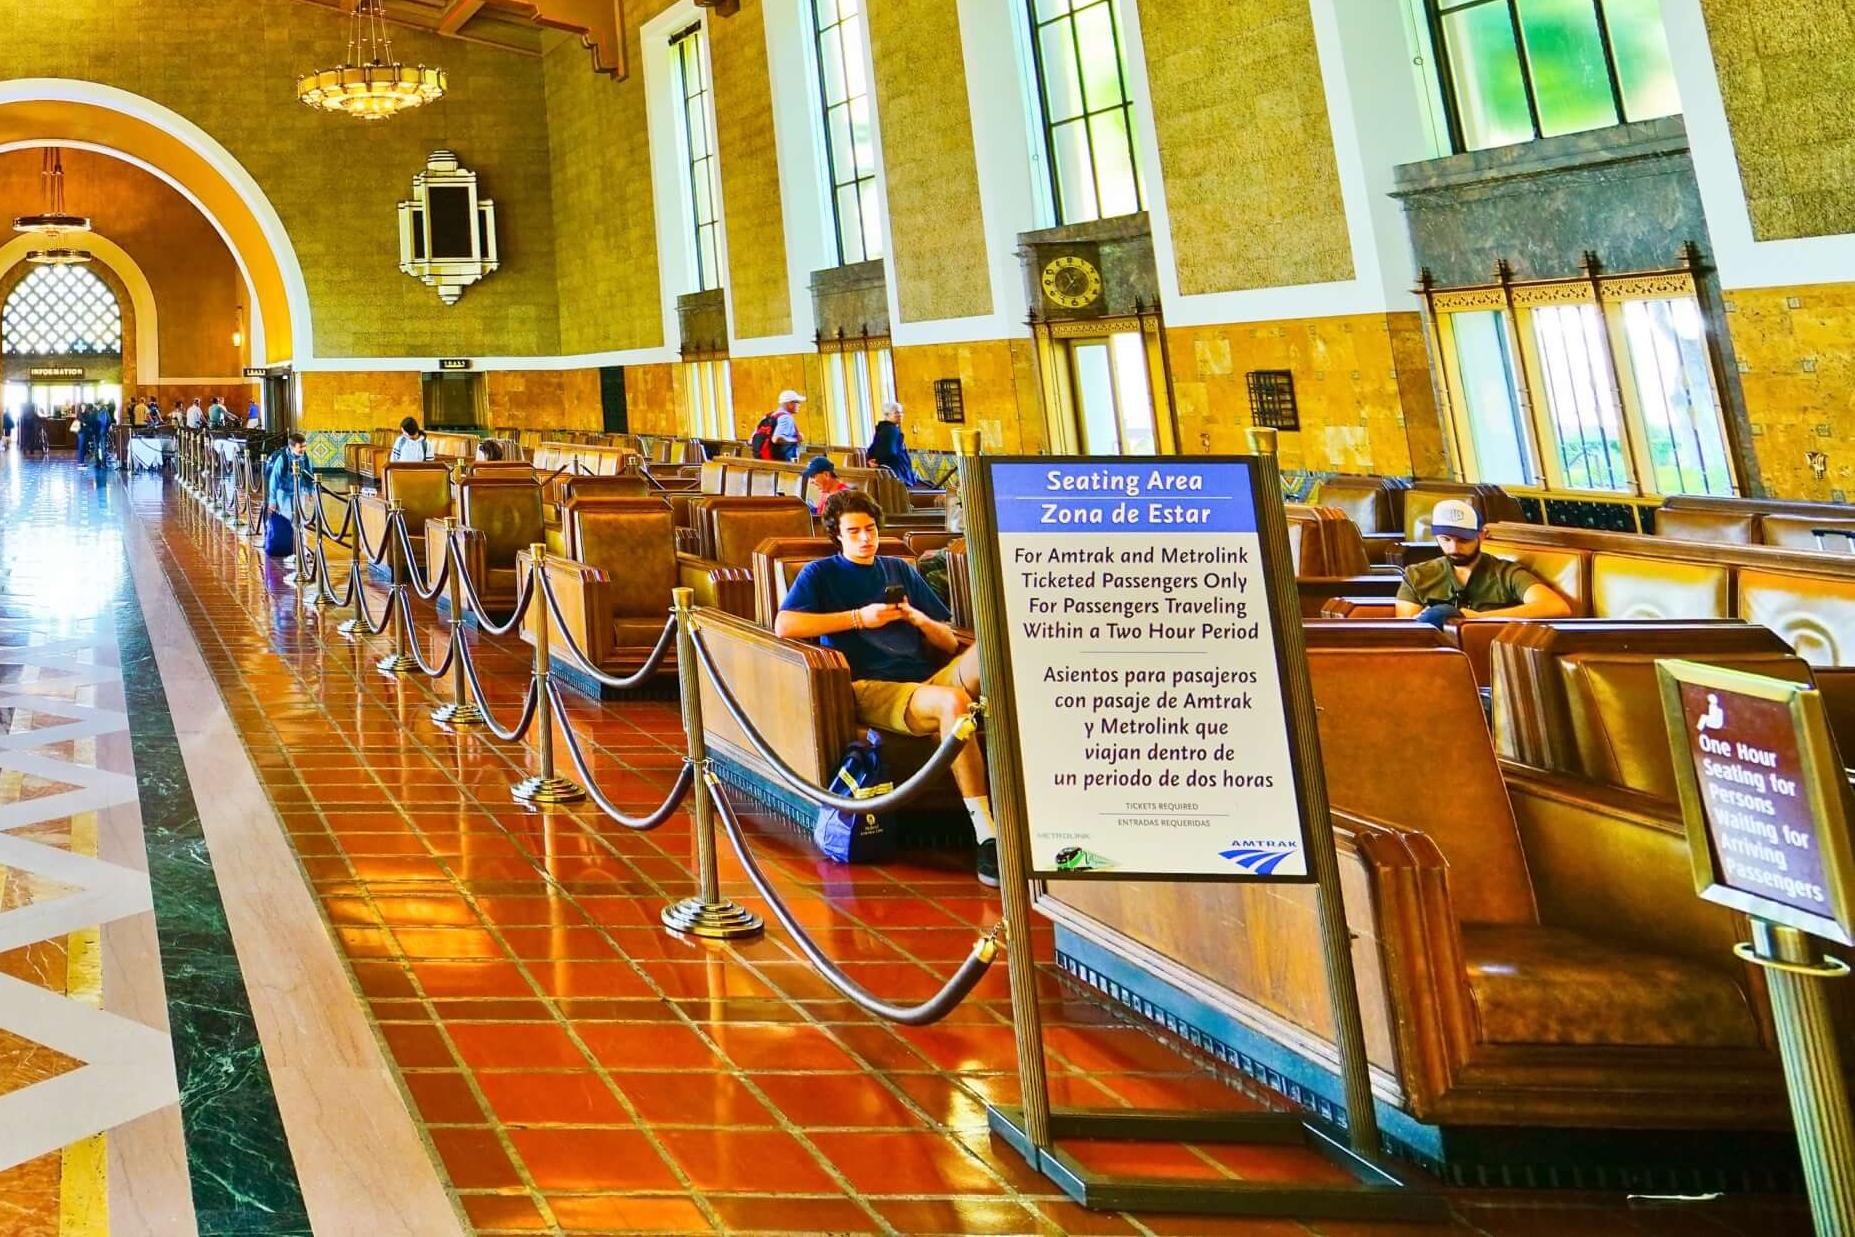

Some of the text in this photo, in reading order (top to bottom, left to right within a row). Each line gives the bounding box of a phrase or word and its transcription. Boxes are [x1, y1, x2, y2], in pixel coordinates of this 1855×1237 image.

[1047, 470, 1203, 496] Seating Area
[1040, 501, 1211, 524] Zona de Estar
[1014, 546, 1248, 564] For Amtrak and Metrolink
[1021, 570, 1247, 594] Ticketed Passengers Only
[1029, 596, 1247, 619] For Passengers Traveling
[1022, 621, 1259, 640] Within a Two Hour Period
[1043, 665, 1257, 689] Asientos para pasajeros
[1054, 690, 1252, 714] con pasaje de Amtrak
[1084, 716, 1229, 740] y Metrolink que
[1085, 742, 1235, 765] viajan dentro de
[1699, 734, 1777, 768] One Hour
[1054, 768, 1274, 791] un periodo de dos horas
[1703, 762, 1796, 797] Seating for
[1125, 802, 1199, 812] TICKETS REQUIRED
[1710, 783, 1775, 815] Persons
[1117, 818, 1211, 828] ENTRADAS REQUERIDAS
[1714, 808, 1809, 849] Waiting for
[1231, 840, 1297, 848] AMTRAK
[1722, 833, 1787, 870] Arriving
[1726, 858, 1825, 902] Passengers
